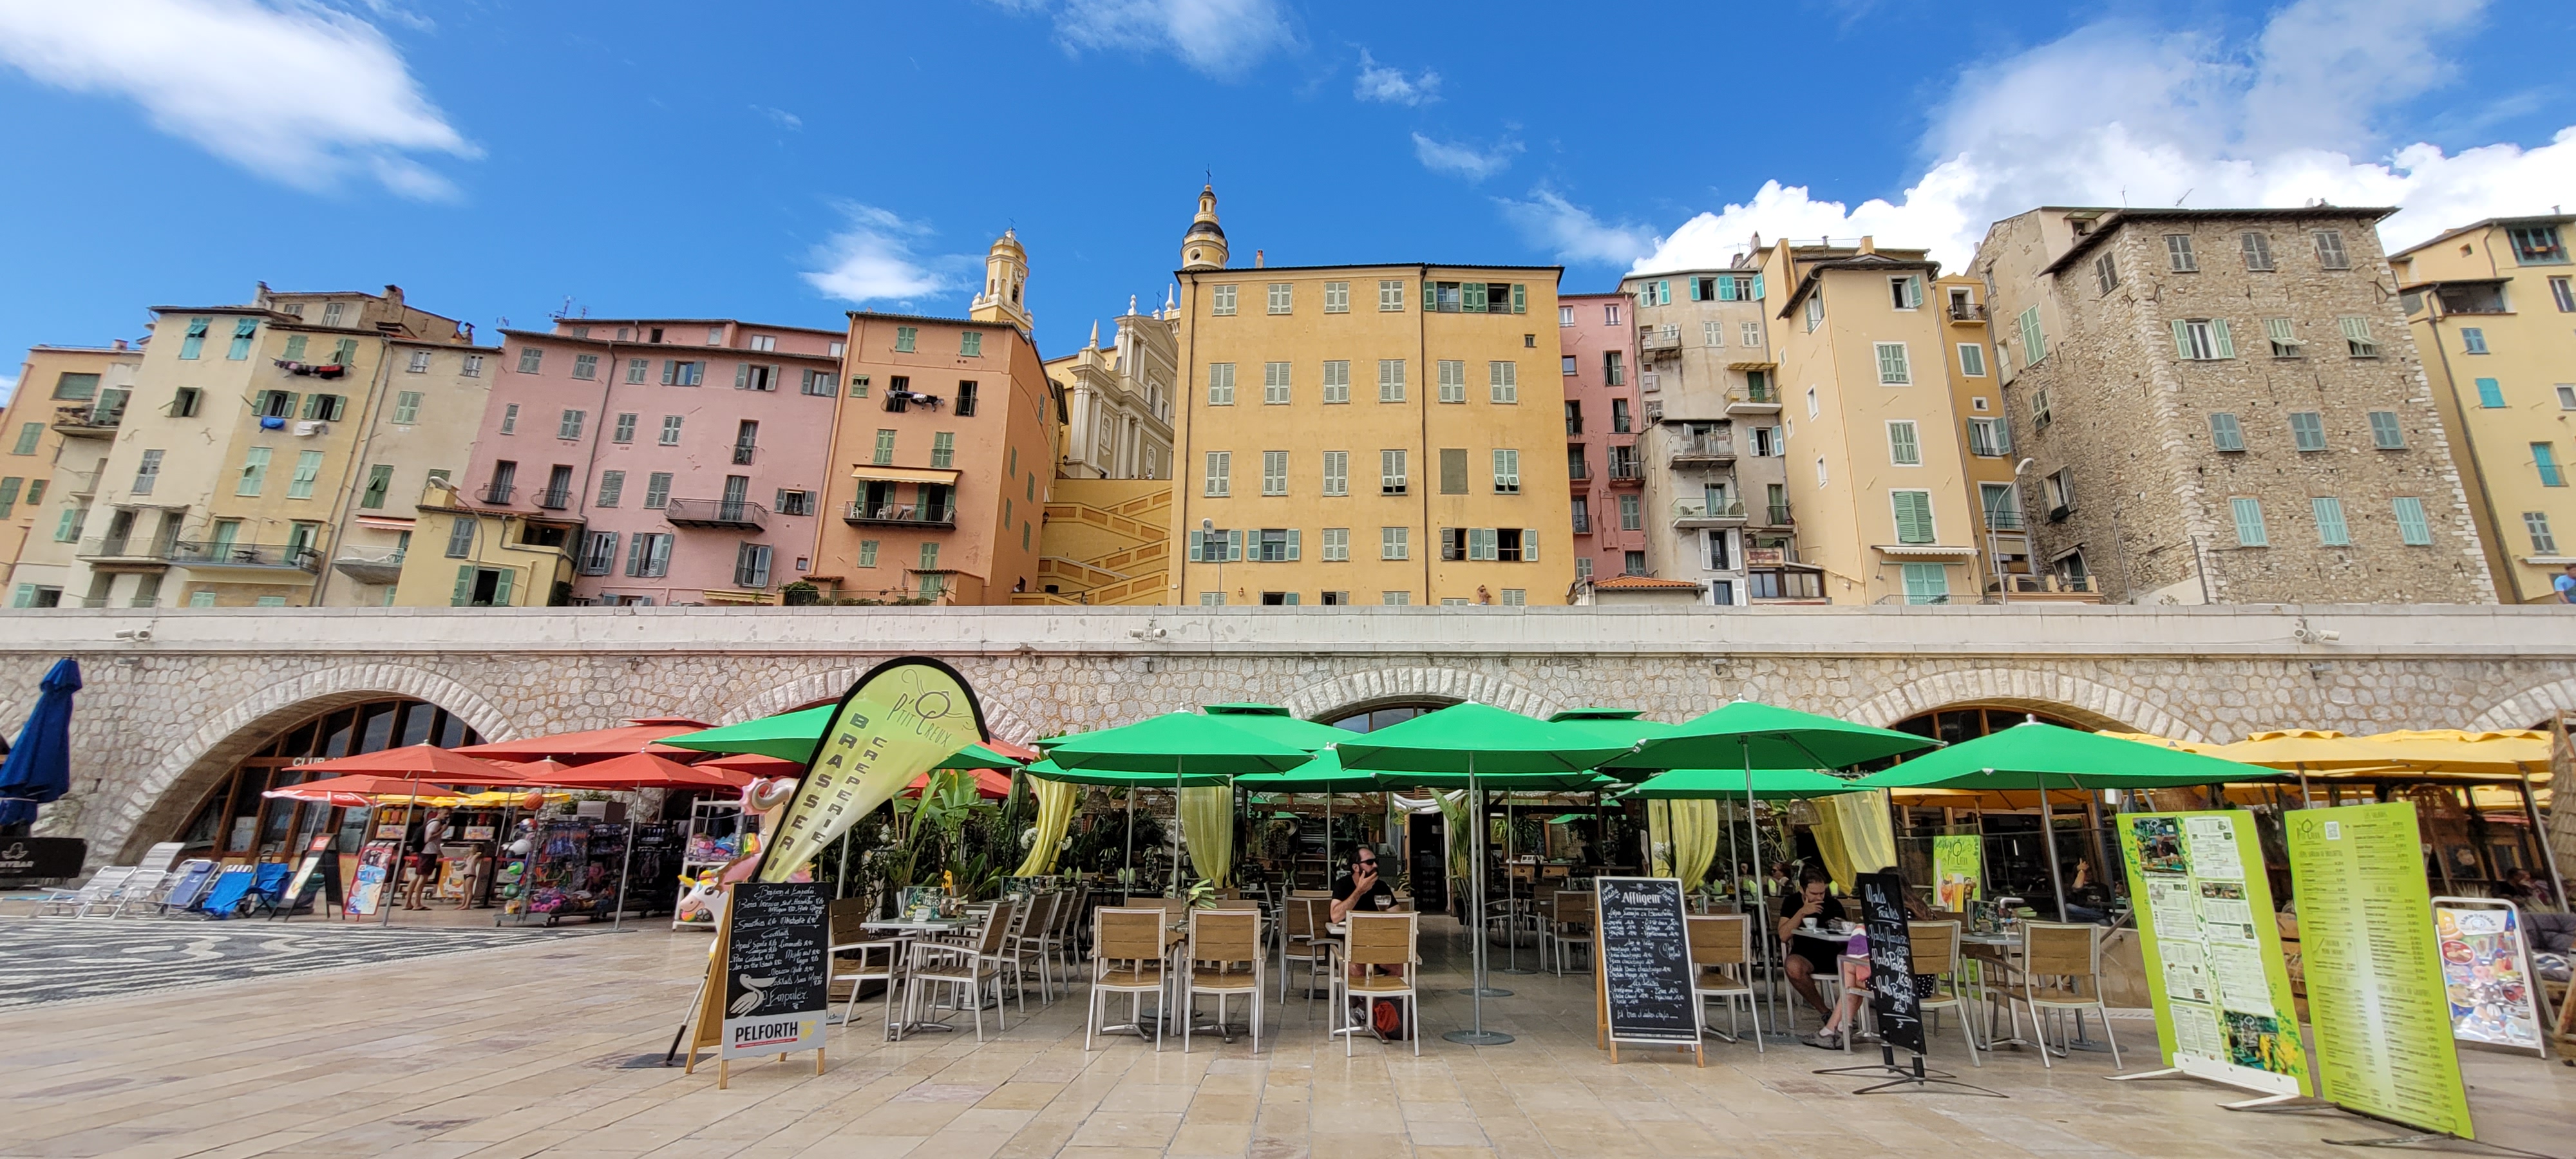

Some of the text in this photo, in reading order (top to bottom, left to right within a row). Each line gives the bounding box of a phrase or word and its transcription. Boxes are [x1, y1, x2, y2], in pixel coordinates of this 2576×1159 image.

[810, 735, 888, 844] CREPERIE
[1621, 891, 1662, 905] Affligem
[735, 1021, 799, 1042] PELFORTH
